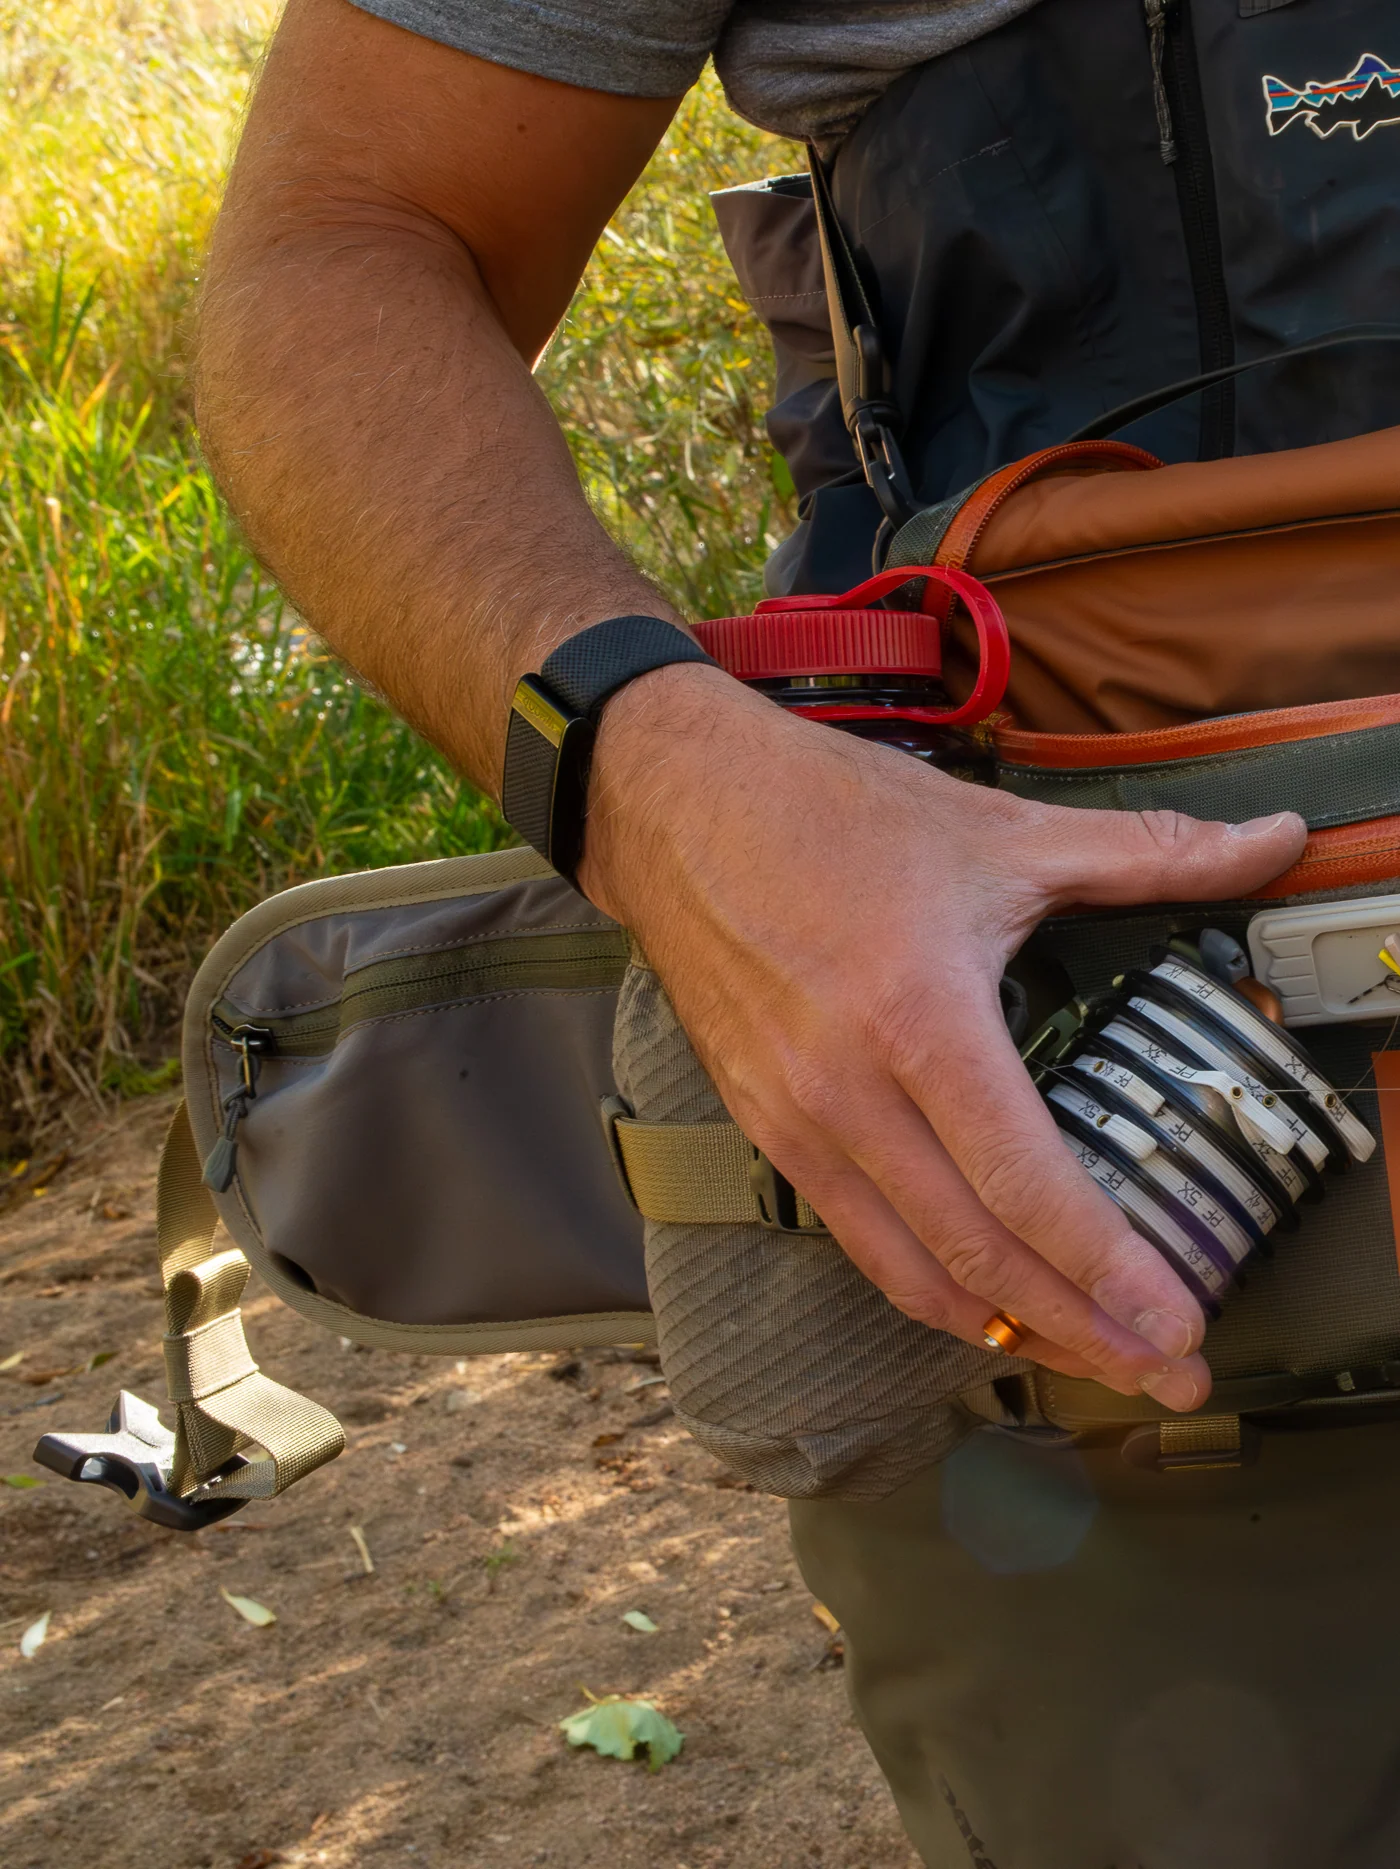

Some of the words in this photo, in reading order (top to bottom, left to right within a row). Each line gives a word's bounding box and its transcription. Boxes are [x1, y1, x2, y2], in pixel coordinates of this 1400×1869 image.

[1165, 961, 1187, 983] 1X
[1189, 976, 1215, 1002] PF
[1141, 1040, 1168, 1066] 3X
[1098, 1061, 1117, 1080] 4X
[1114, 1069, 1133, 1089] PF
[1168, 1057, 1197, 1085] PF
[1283, 1055, 1312, 1082] 1X
[1079, 1098, 1101, 1121] 5X
[1168, 1117, 1194, 1142] PF
[1075, 1145, 1101, 1170] 6X
[1249, 1136, 1278, 1164] 3X
[1099, 1164, 1127, 1191] PF
[1274, 1163, 1298, 1187] PF
[1176, 1180, 1204, 1207] 5X
[1201, 1204, 1225, 1229] PF
[1181, 1241, 1206, 1266] 6X
[1198, 1261, 1217, 1281] PF
